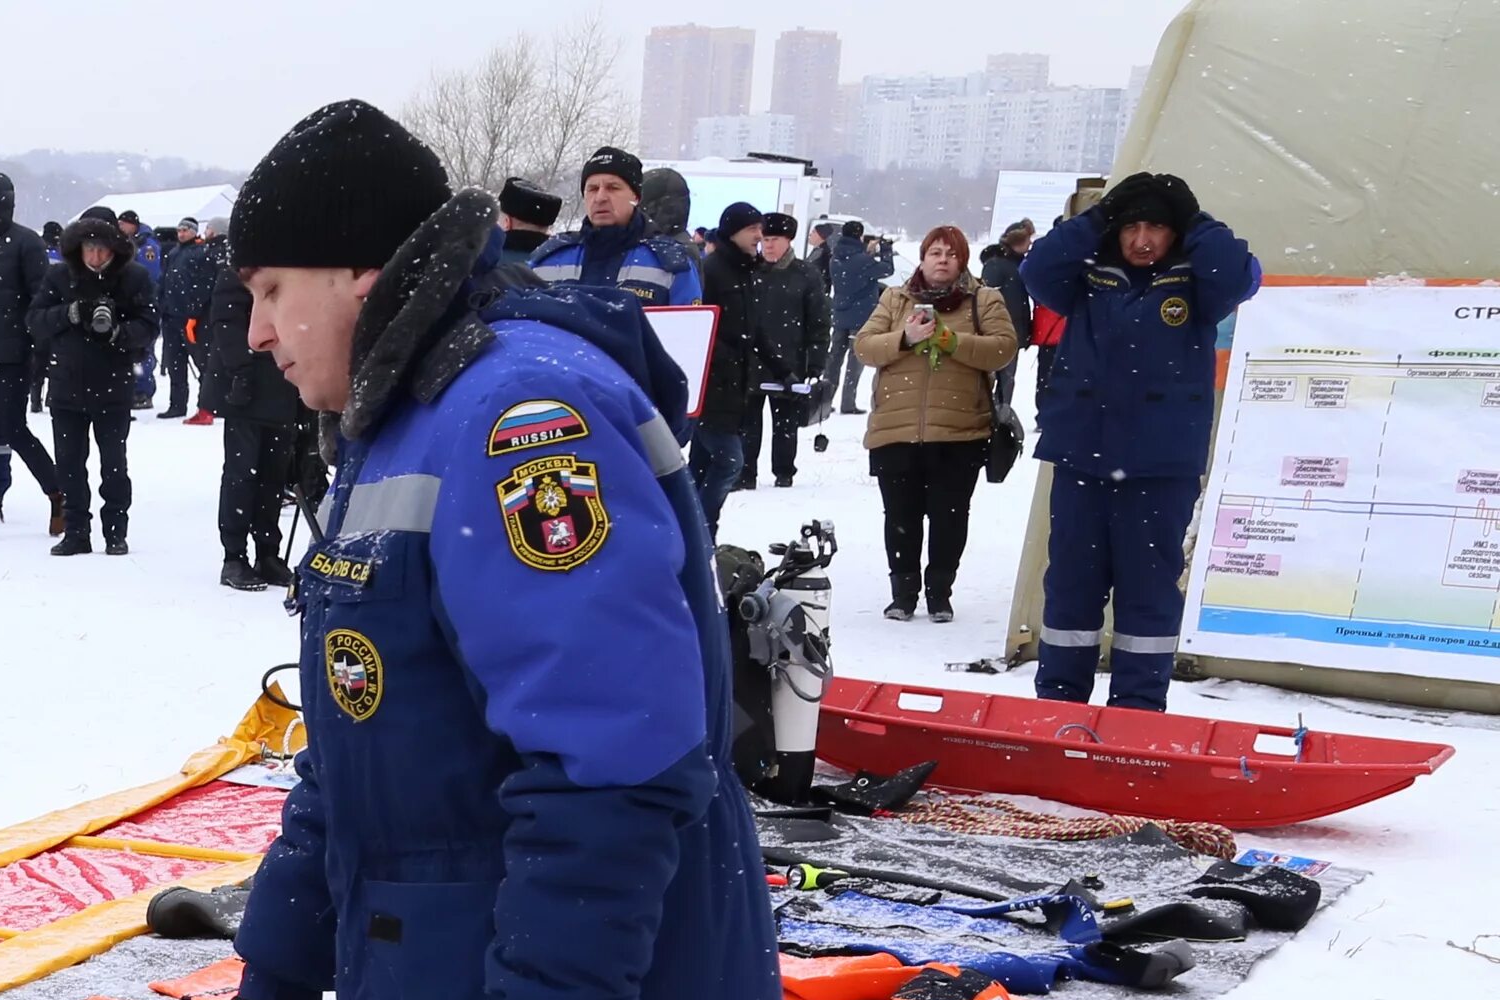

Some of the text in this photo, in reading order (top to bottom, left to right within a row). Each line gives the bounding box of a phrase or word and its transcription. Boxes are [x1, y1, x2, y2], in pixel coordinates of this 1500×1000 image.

[511, 428, 563, 446] RUSSIA
[519, 459, 571, 478] МОСКВА
[1335, 626, 1383, 638] Прочный
[1428, 636, 1465, 646] покров
[337, 635, 377, 674] РОССИИ
